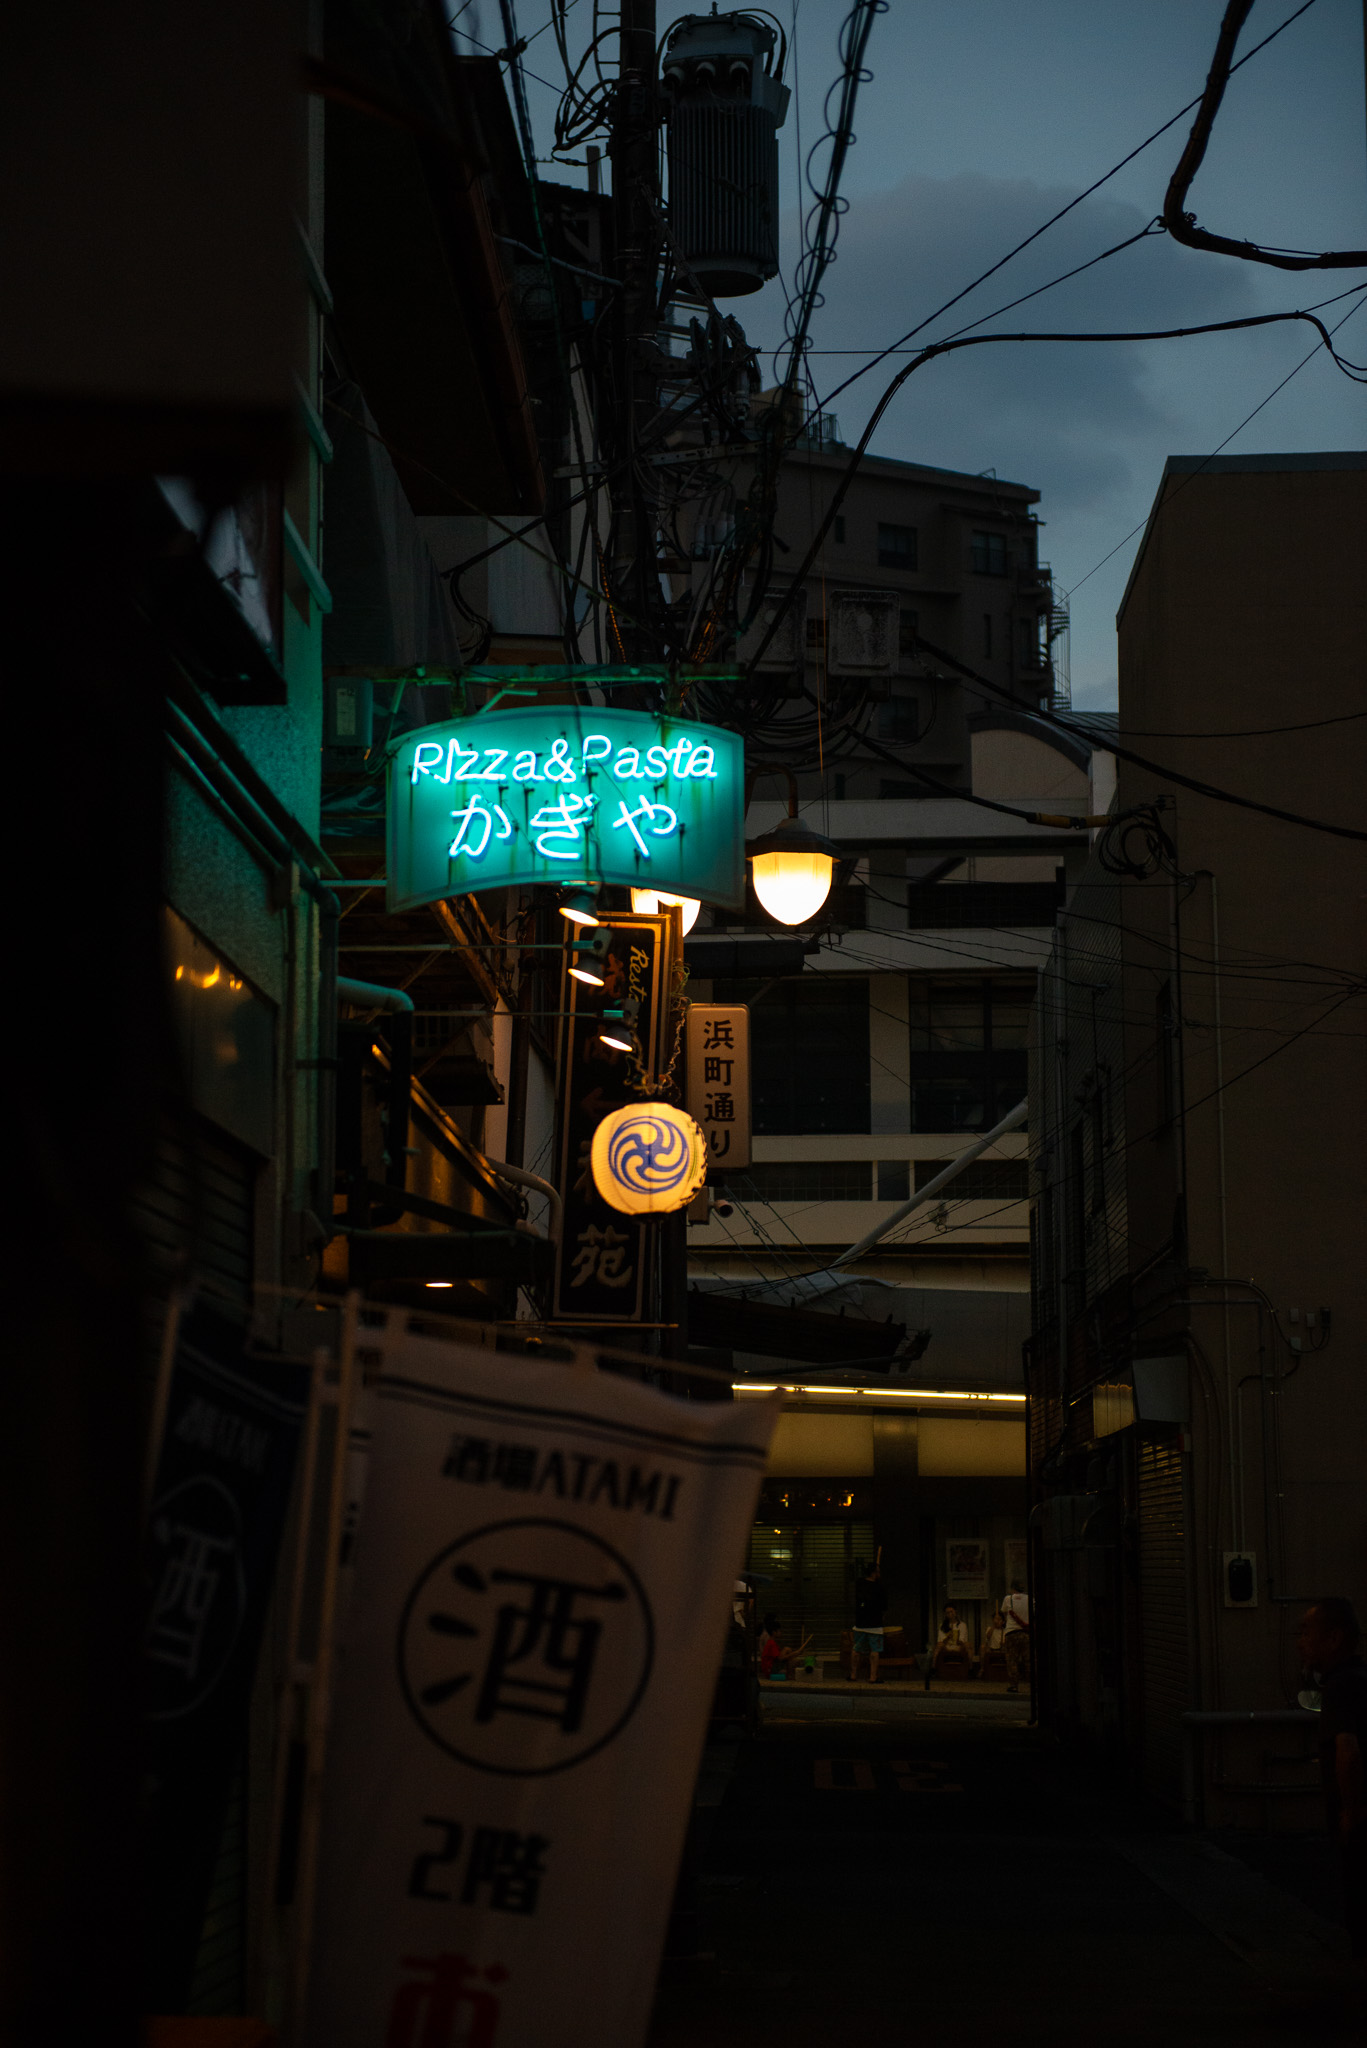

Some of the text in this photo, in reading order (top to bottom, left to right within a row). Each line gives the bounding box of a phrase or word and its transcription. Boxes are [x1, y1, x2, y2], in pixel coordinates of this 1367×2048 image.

[448, 793, 678, 860] かぎや
[703, 1019, 736, 1158] 浜町通り
[421, 1563, 628, 1735] 酒
[408, 1815, 551, 1918] 2階
